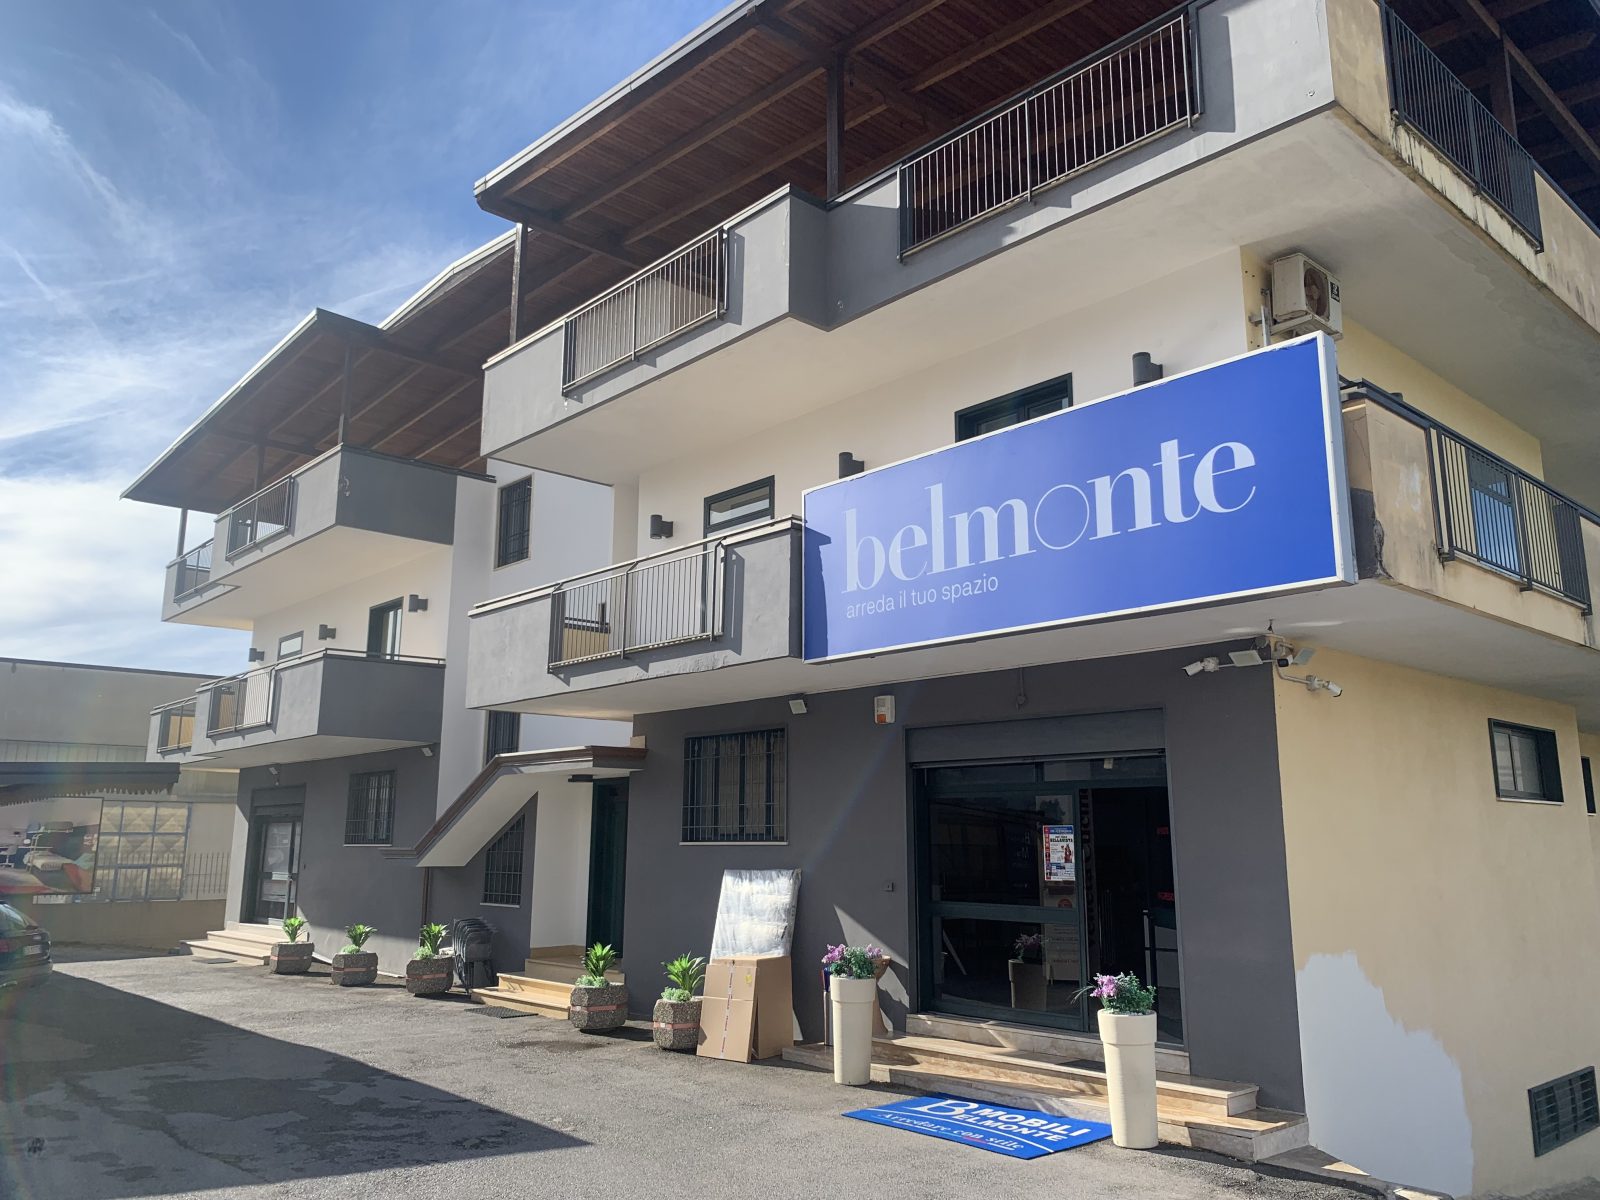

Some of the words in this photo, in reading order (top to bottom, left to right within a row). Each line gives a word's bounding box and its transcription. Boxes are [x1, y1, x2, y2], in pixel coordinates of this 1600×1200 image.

[841, 438, 1257, 594] belmonte
[846, 594, 895, 619] arreda
[898, 590, 907, 609] il
[911, 589, 937, 606] tuo
[941, 573, 999, 603] spazio
[953, 1129, 984, 1140] con
[971, 1108, 1092, 1137] MOBILI
